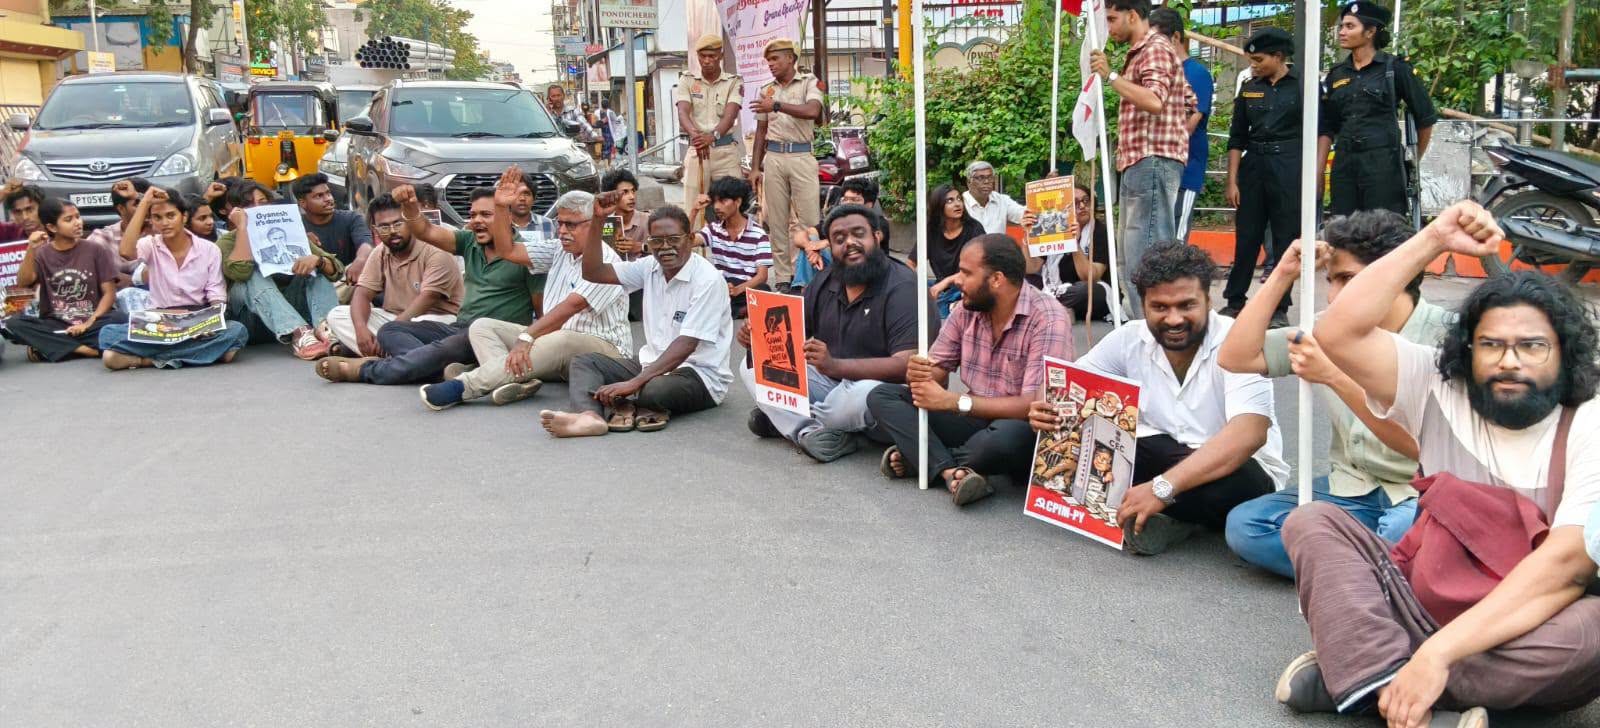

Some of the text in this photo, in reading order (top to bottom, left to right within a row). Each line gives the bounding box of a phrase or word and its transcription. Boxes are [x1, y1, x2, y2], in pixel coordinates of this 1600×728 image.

[601, 11, 657, 19] PONDICHERRY
[249, 68, 276, 76] ERVICE
[256, 210, 289, 220] Gyanesh
[1040, 243, 1065, 253] CPIM
[767, 390, 798, 408] CPIM
[1109, 440, 1125, 453] CEC
[1046, 501, 1085, 523] CPIM-PY
